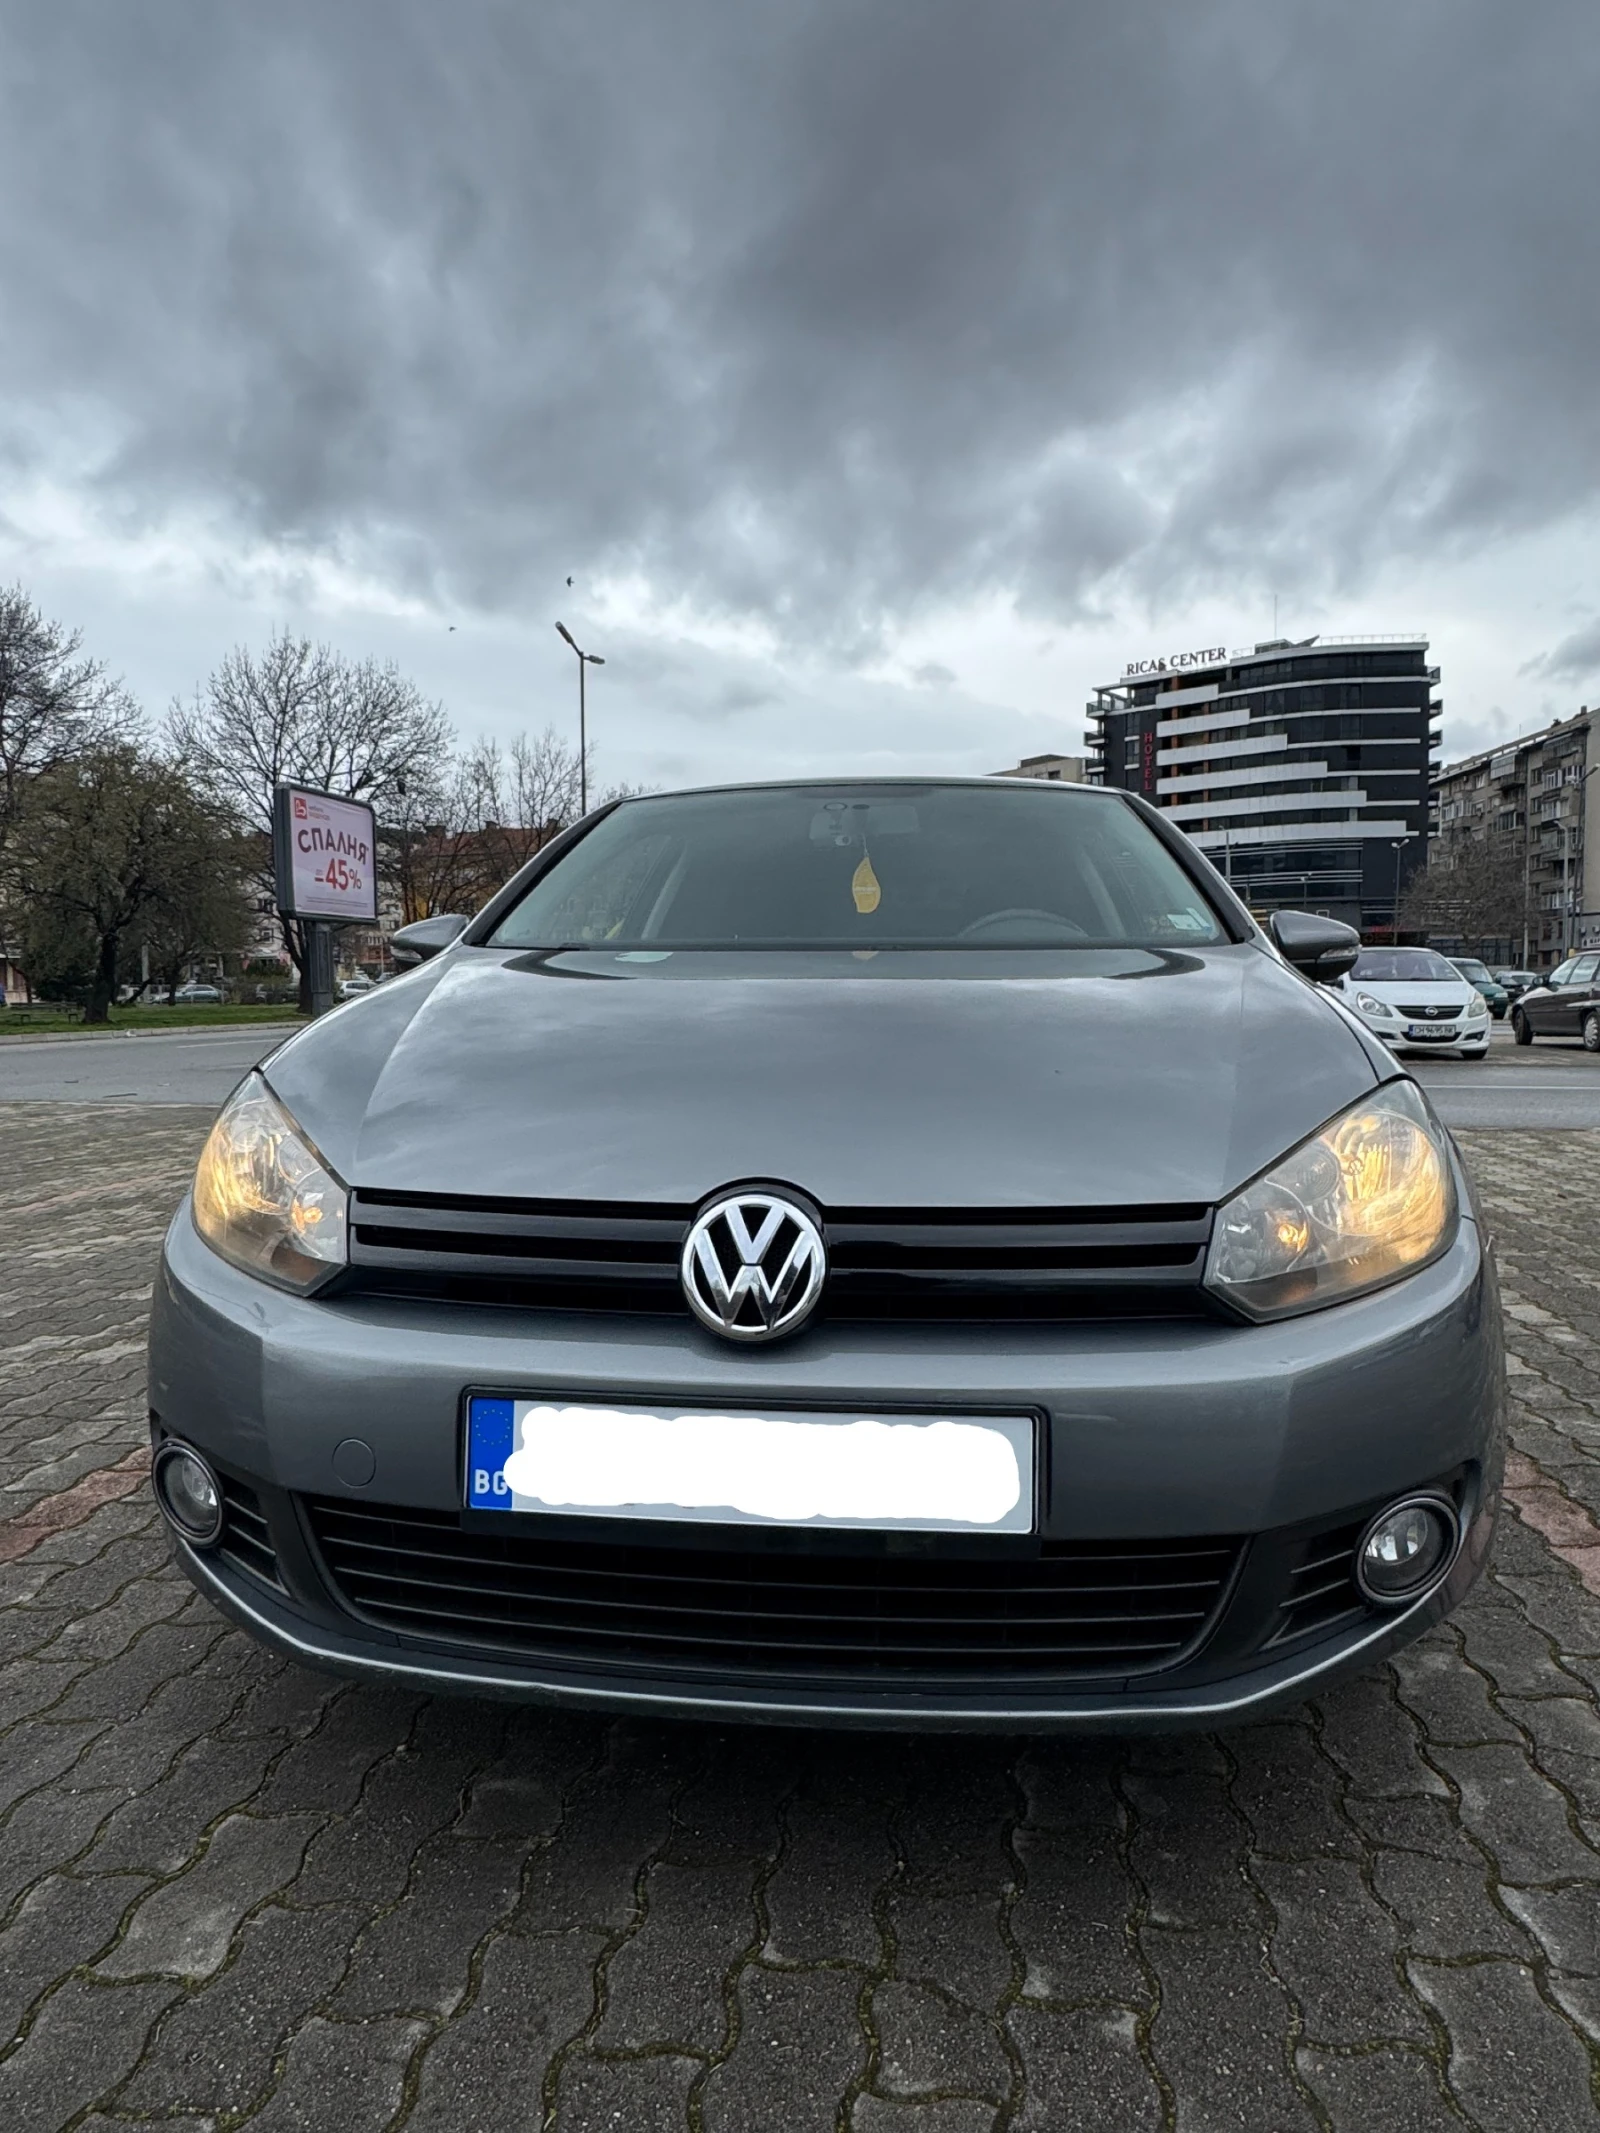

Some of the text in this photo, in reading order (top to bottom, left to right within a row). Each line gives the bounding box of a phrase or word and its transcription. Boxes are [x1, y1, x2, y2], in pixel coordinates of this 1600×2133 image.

[1170, 647, 1226, 667] CENTER
[1144, 732, 1153, 790] HOTEL
[297, 828, 367, 865] СПАЛНЯ
[475, 1469, 508, 1495] BG
